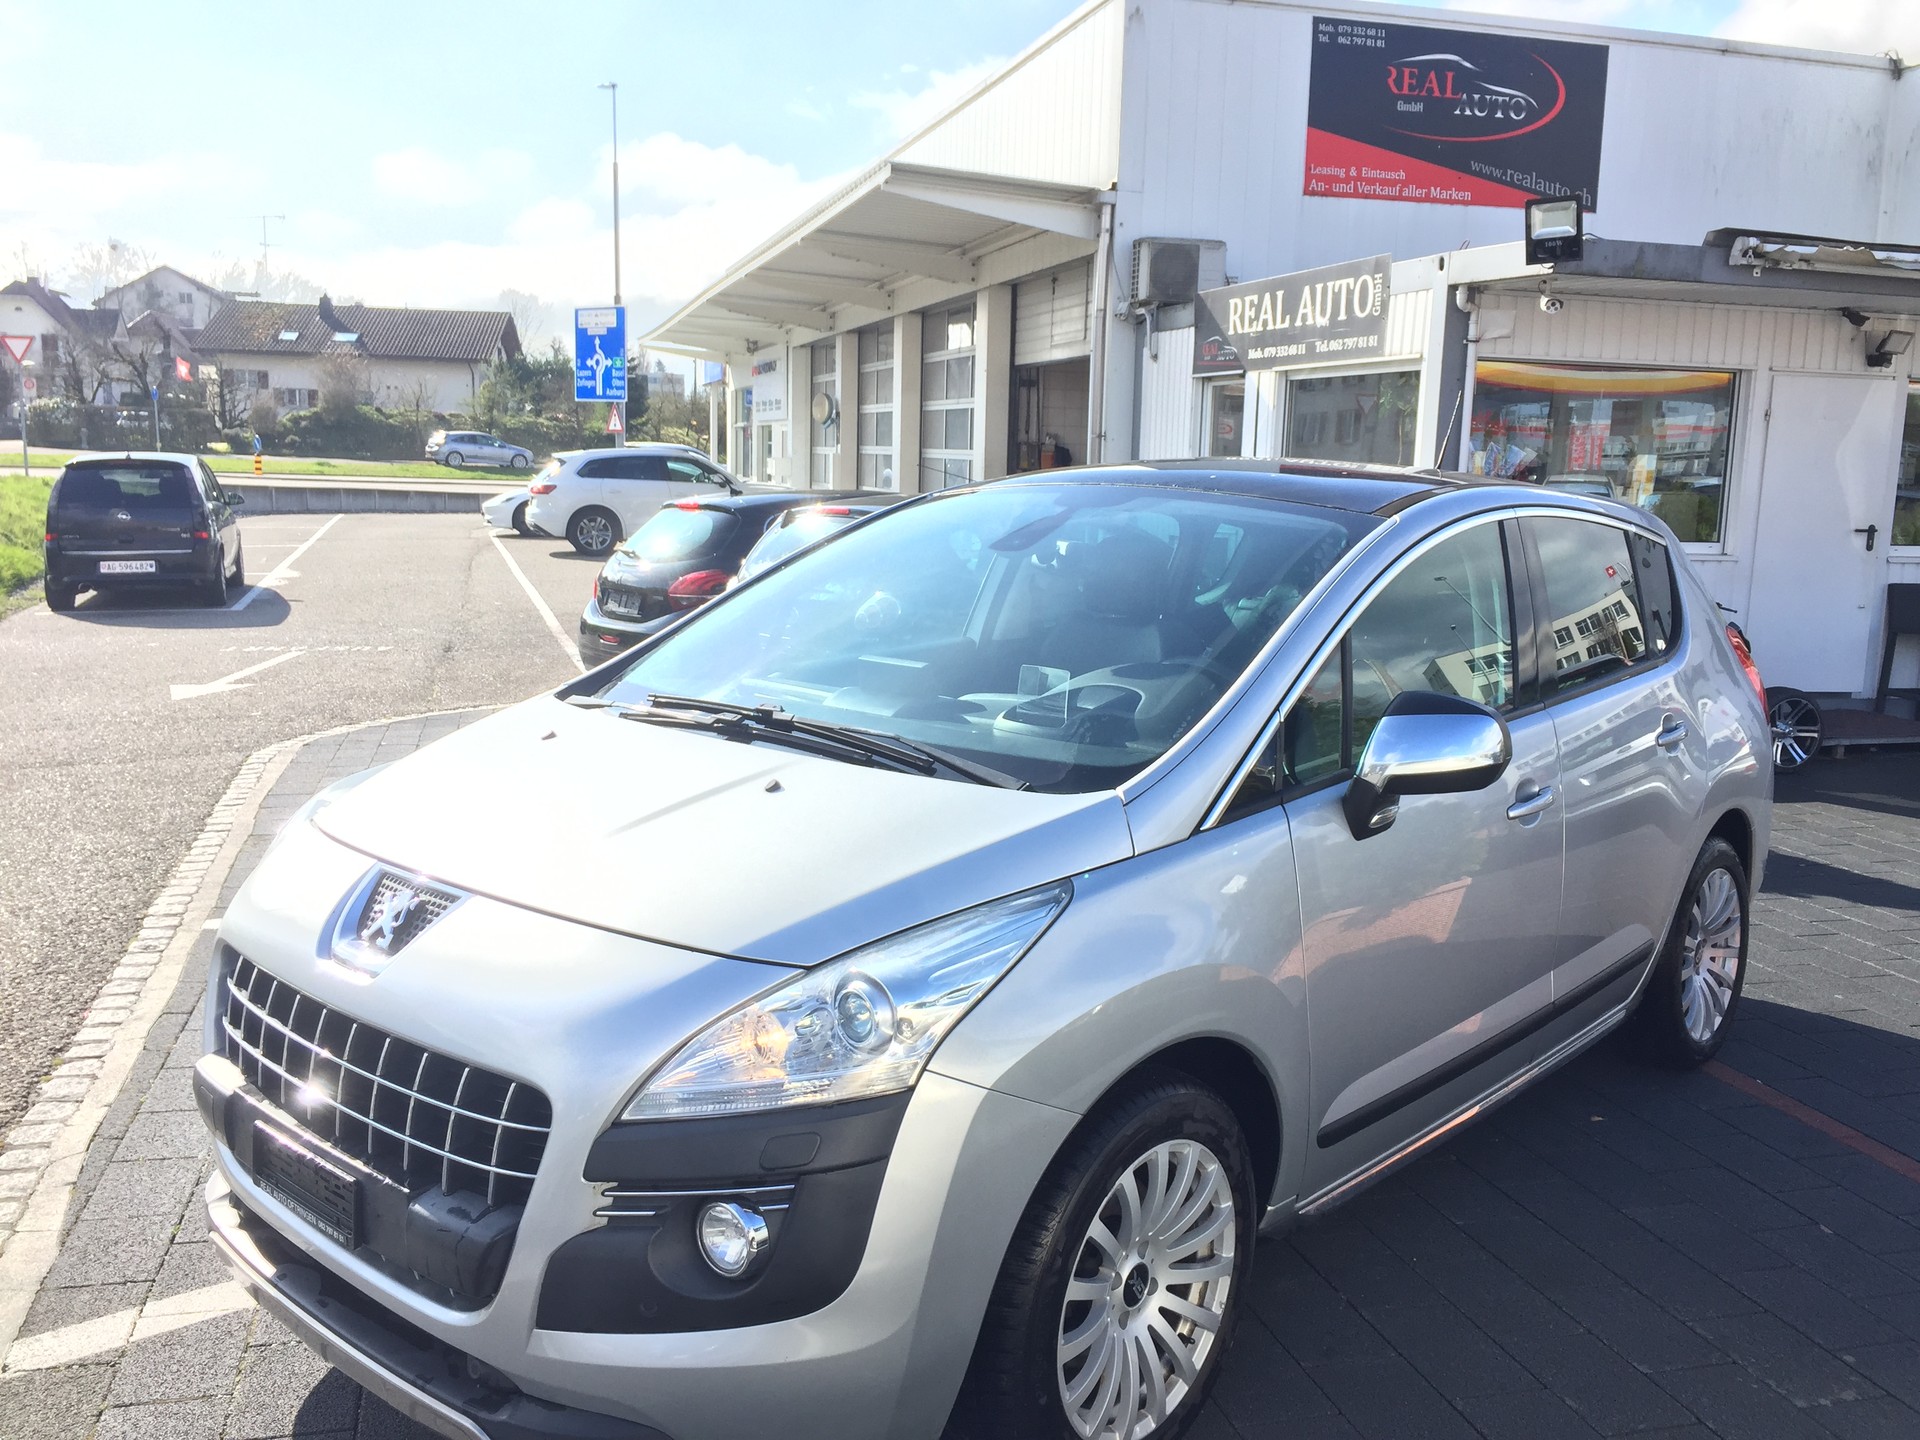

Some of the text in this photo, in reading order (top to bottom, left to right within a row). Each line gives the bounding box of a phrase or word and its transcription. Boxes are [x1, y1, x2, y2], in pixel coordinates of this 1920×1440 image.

[1318, 23, 1385, 37] Mob. 079 332 68 11
[1318, 34, 1385, 48] Tel. 062 797 81 81
[1387, 66, 1462, 98] REAL
[1397, 100, 1423, 112] GmbH
[1454, 93, 1527, 120] AUTO
[1310, 164, 1406, 180] Leasing & Eintausch
[1309, 179, 1472, 200] An- und Verkauf aller Marken
[1471, 161, 1591, 206] www.realautoh
[1228, 274, 1374, 335] REAL AUTO
[1372, 272, 1382, 316] GmbH
[1329, 339, 1342, 351] 062
[1344, 337, 1358, 350] 797
[1358, 336, 1367, 348] 81
[1368, 335, 1378, 346] 81
[107, 562, 116, 571] AG
[260, 1181, 273, 1197] REAL
[273, 1190, 287, 1206] AUTO
